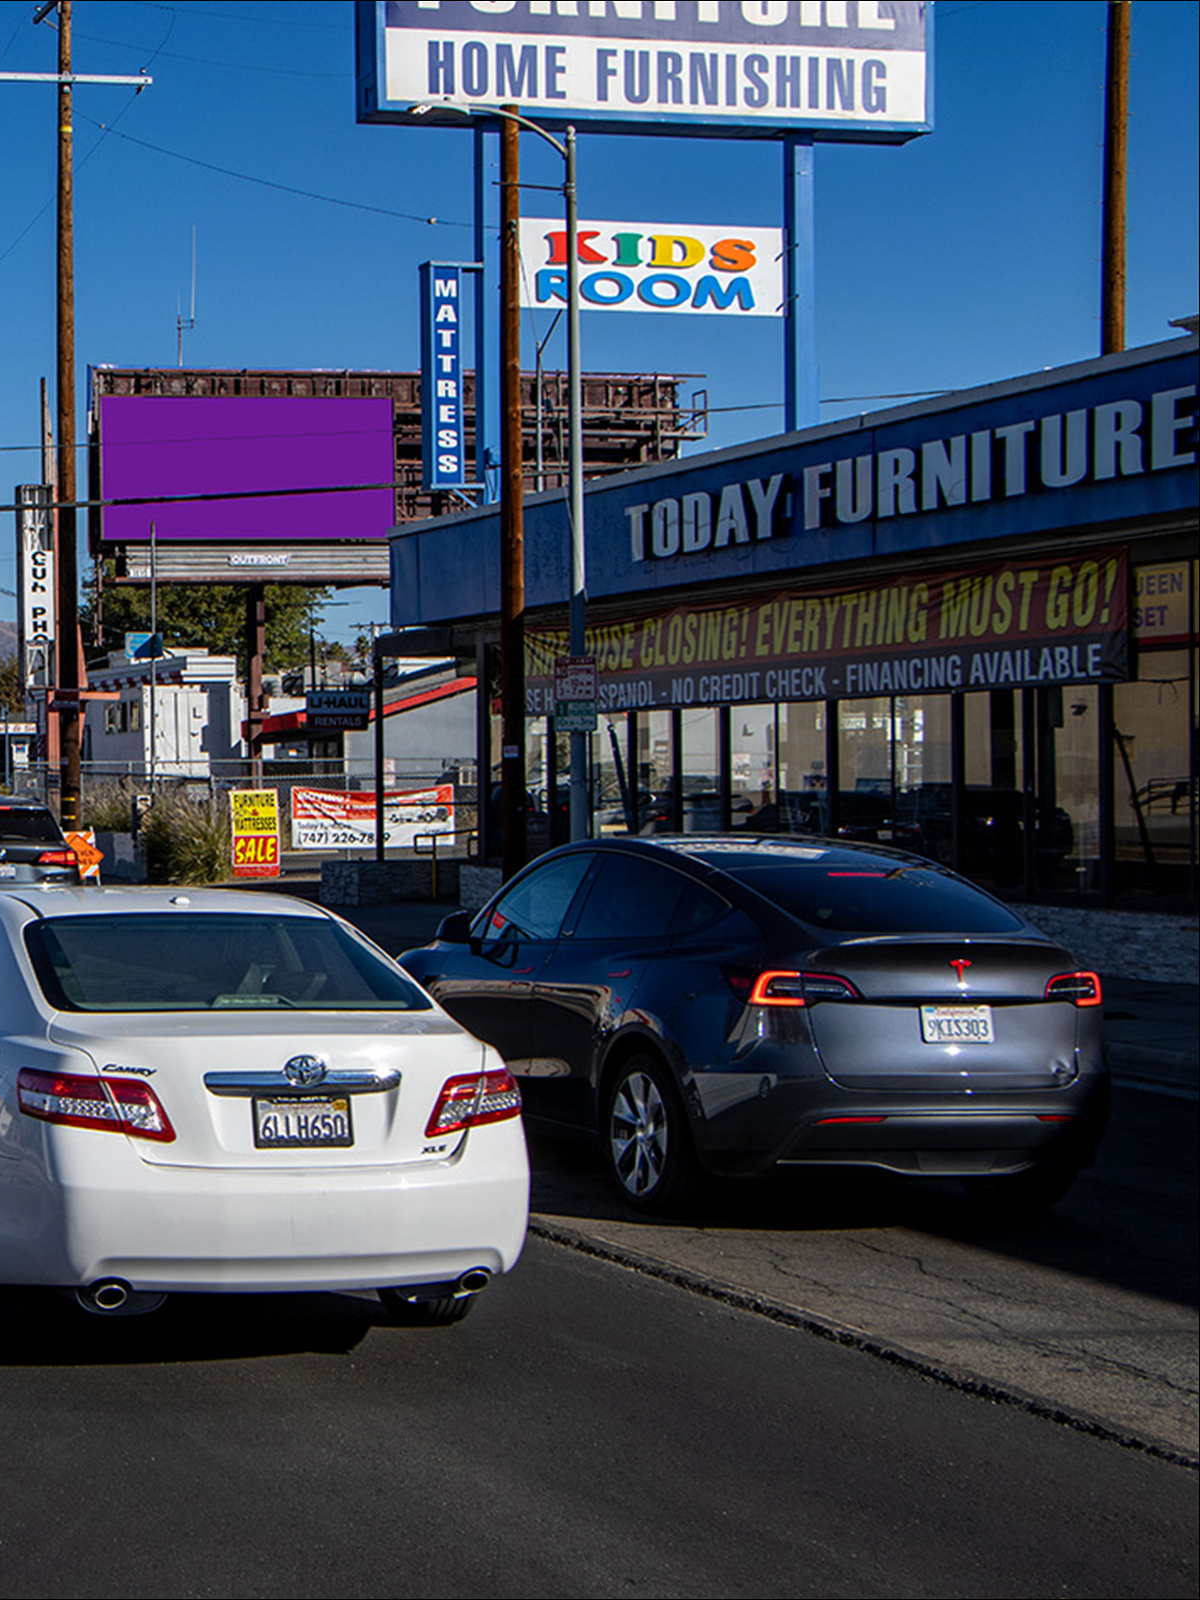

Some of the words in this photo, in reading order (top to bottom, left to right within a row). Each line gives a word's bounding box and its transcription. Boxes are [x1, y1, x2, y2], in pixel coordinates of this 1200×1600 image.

[428, 40, 567, 99] HOME
[596, 47, 888, 114] FURNISHING
[543, 230, 757, 272] KIDS
[535, 269, 756, 310] ROOM
[434, 279, 458, 474] MATTRESS
[624, 473, 784, 563] TODAY
[804, 385, 1198, 530] FURNITURE
[232, 554, 288, 565] OUTFRONT
[1132, 571, 1183, 596] UEEN
[641, 605, 748, 667] CLOSING!
[756, 584, 928, 660] EVERYTHING
[940, 571, 1039, 638] MUST
[1047, 558, 1118, 629] GO!
[1131, 605, 1169, 628] SET
[599, 680, 656, 709] SPANOL
[672, 678, 695, 705] NO
[699, 671, 760, 701] CREDIT
[766, 665, 827, 698] CHECK
[847, 655, 963, 693] FINANCING
[970, 643, 1102, 687] AVAILABLE
[310, 696, 367, 708] U-HAUL
[315, 716, 362, 727] RENTALS
[234, 793, 275, 808] FURNITURE
[235, 816, 277, 831] MATTRESSES
[235, 836, 277, 863] SALE
[298, 832, 329, 845] (747)
[332, 832, 392, 844] 226-789
[927, 1018, 990, 1037] 9KIS303
[261, 1113, 346, 1140] 6LLH650
